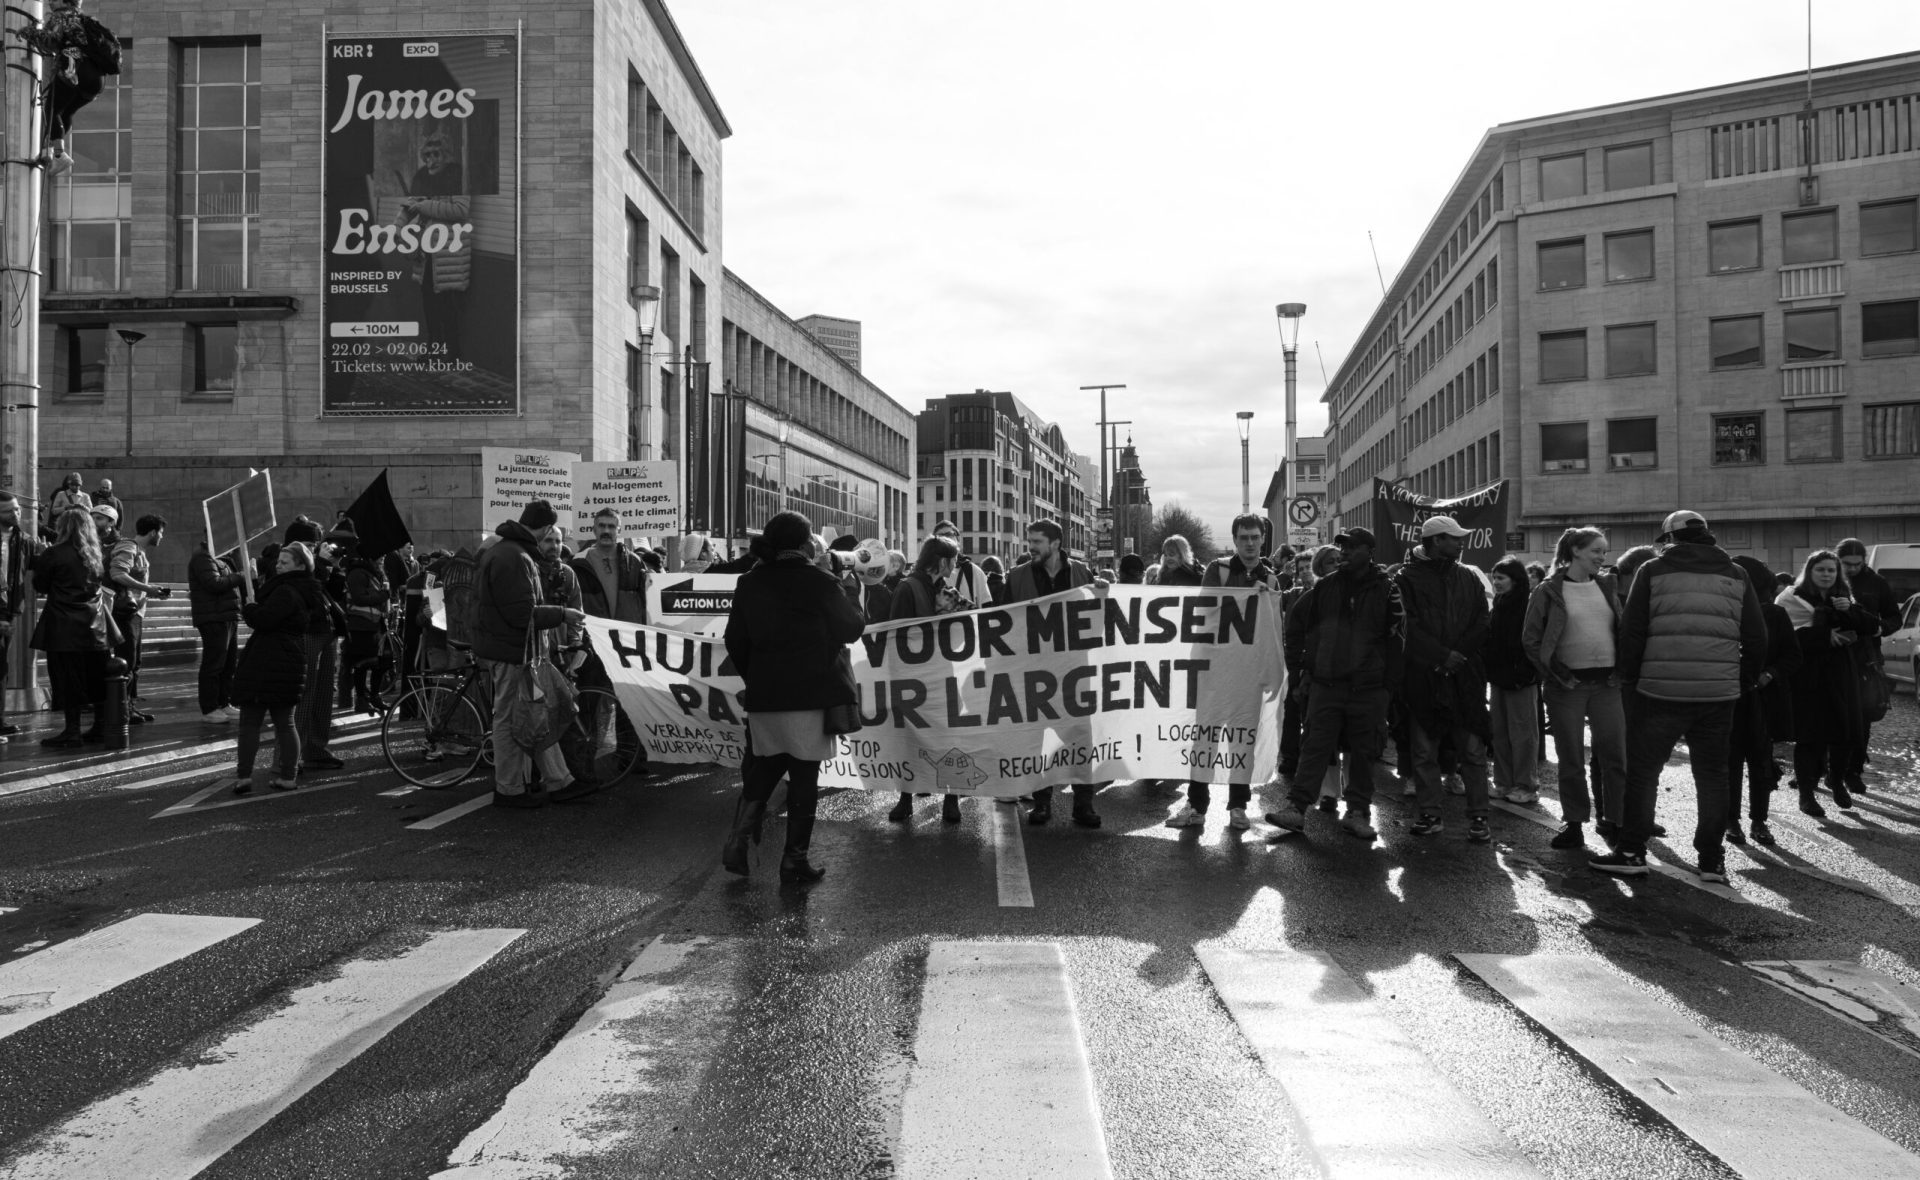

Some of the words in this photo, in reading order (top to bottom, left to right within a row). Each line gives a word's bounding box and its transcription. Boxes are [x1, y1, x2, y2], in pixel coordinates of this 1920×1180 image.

[333, 45, 363, 58] KBR
[406, 45, 436, 55] EXPO
[330, 74, 477, 134] James
[331, 208, 473, 255] Ensor
[330, 271, 384, 281] INSPIRED
[387, 271, 402, 280] BY
[330, 284, 388, 294] BRUSSELS
[366, 324, 400, 335] 100M
[331, 343, 371, 356] 22.02
[387, 342, 448, 355] 02.06.24
[331, 360, 387, 373] Tickets:
[390, 357, 473, 373] www.kbr.be
[498, 464, 508, 472] La
[509, 464, 537, 475] justice
[538, 466, 568, 477] sociale
[519, 478, 533, 486] par
[548, 479, 572, 488] Pacte
[592, 480, 663, 491] Mal-logement
[490, 500, 509, 508] pour
[584, 497, 590, 505] à
[593, 496, 616, 504] tous
[618, 495, 633, 504] les
[635, 494, 671, 504] étages,
[578, 511, 588, 519] la
[622, 509, 633, 517] et
[635, 509, 644, 517] le
[646, 507, 677, 516] climat
[624, 521, 671, 532] naufrage
[1392, 522, 1422, 543] THE
[673, 598, 714, 609] ACTION
[861, 610, 1015, 667] VOOR
[1026, 595, 1259, 655] MENSEN
[669, 683, 747, 725] PA
[858, 678, 931, 729] UR
[946, 659, 1210, 728] L'ARGENT
[645, 723, 714, 740] VERLAAG
[718, 731, 740, 743] DE
[1158, 724, 1256, 745] LOGEMENTS
[840, 739, 881, 759] STOP
[818, 759, 915, 782] PULSIONS
